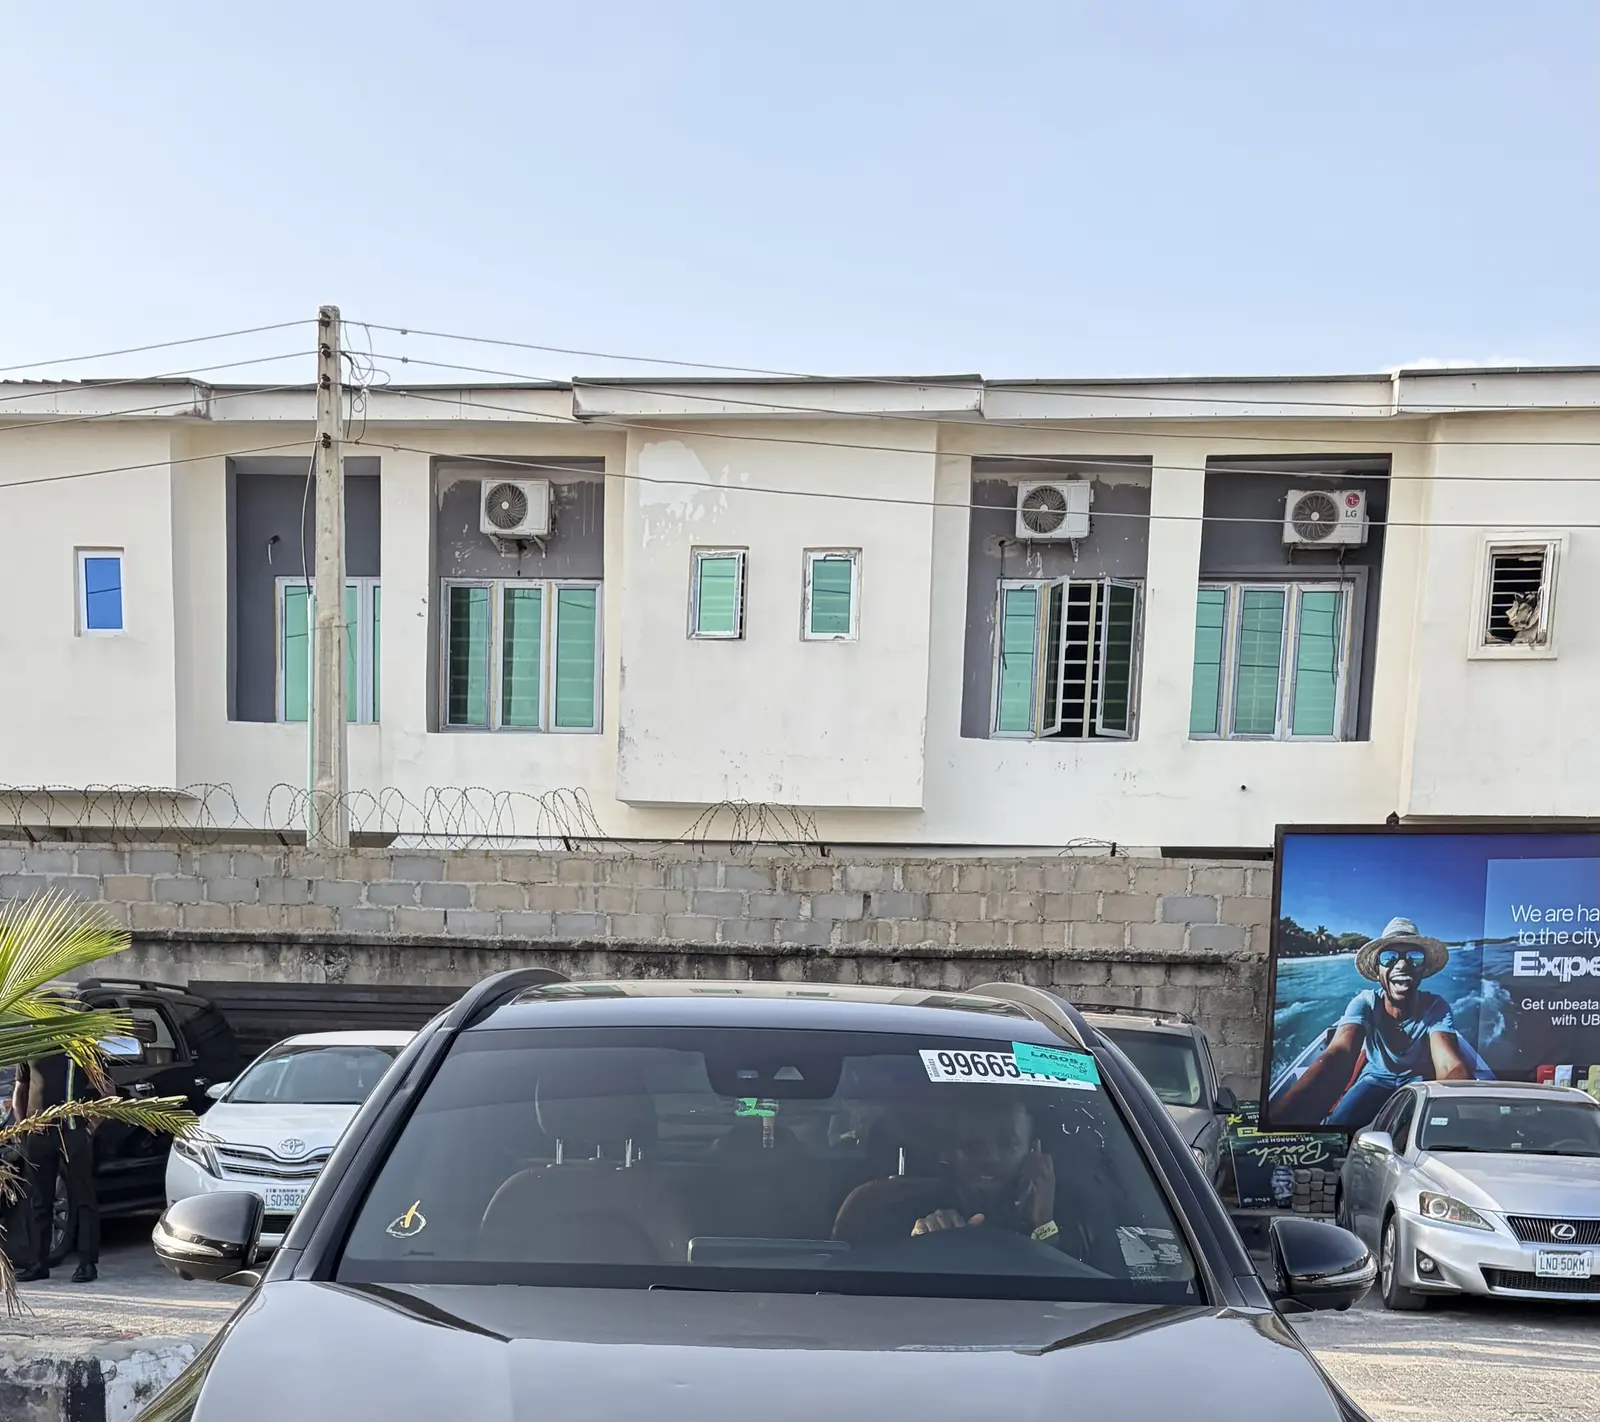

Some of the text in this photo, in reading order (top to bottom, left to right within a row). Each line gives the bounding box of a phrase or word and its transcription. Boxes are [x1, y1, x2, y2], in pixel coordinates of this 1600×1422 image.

[1345, 510, 1357, 518] LG
[1511, 904, 1600, 922] We are ha
[1518, 927, 1600, 948] to the city
[1521, 998, 1600, 1010] Get unbeata
[1551, 1014, 1600, 1026] with UB
[1030, 1051, 1078, 1064] LAGOS
[1247, 1141, 1329, 1167] Beach
